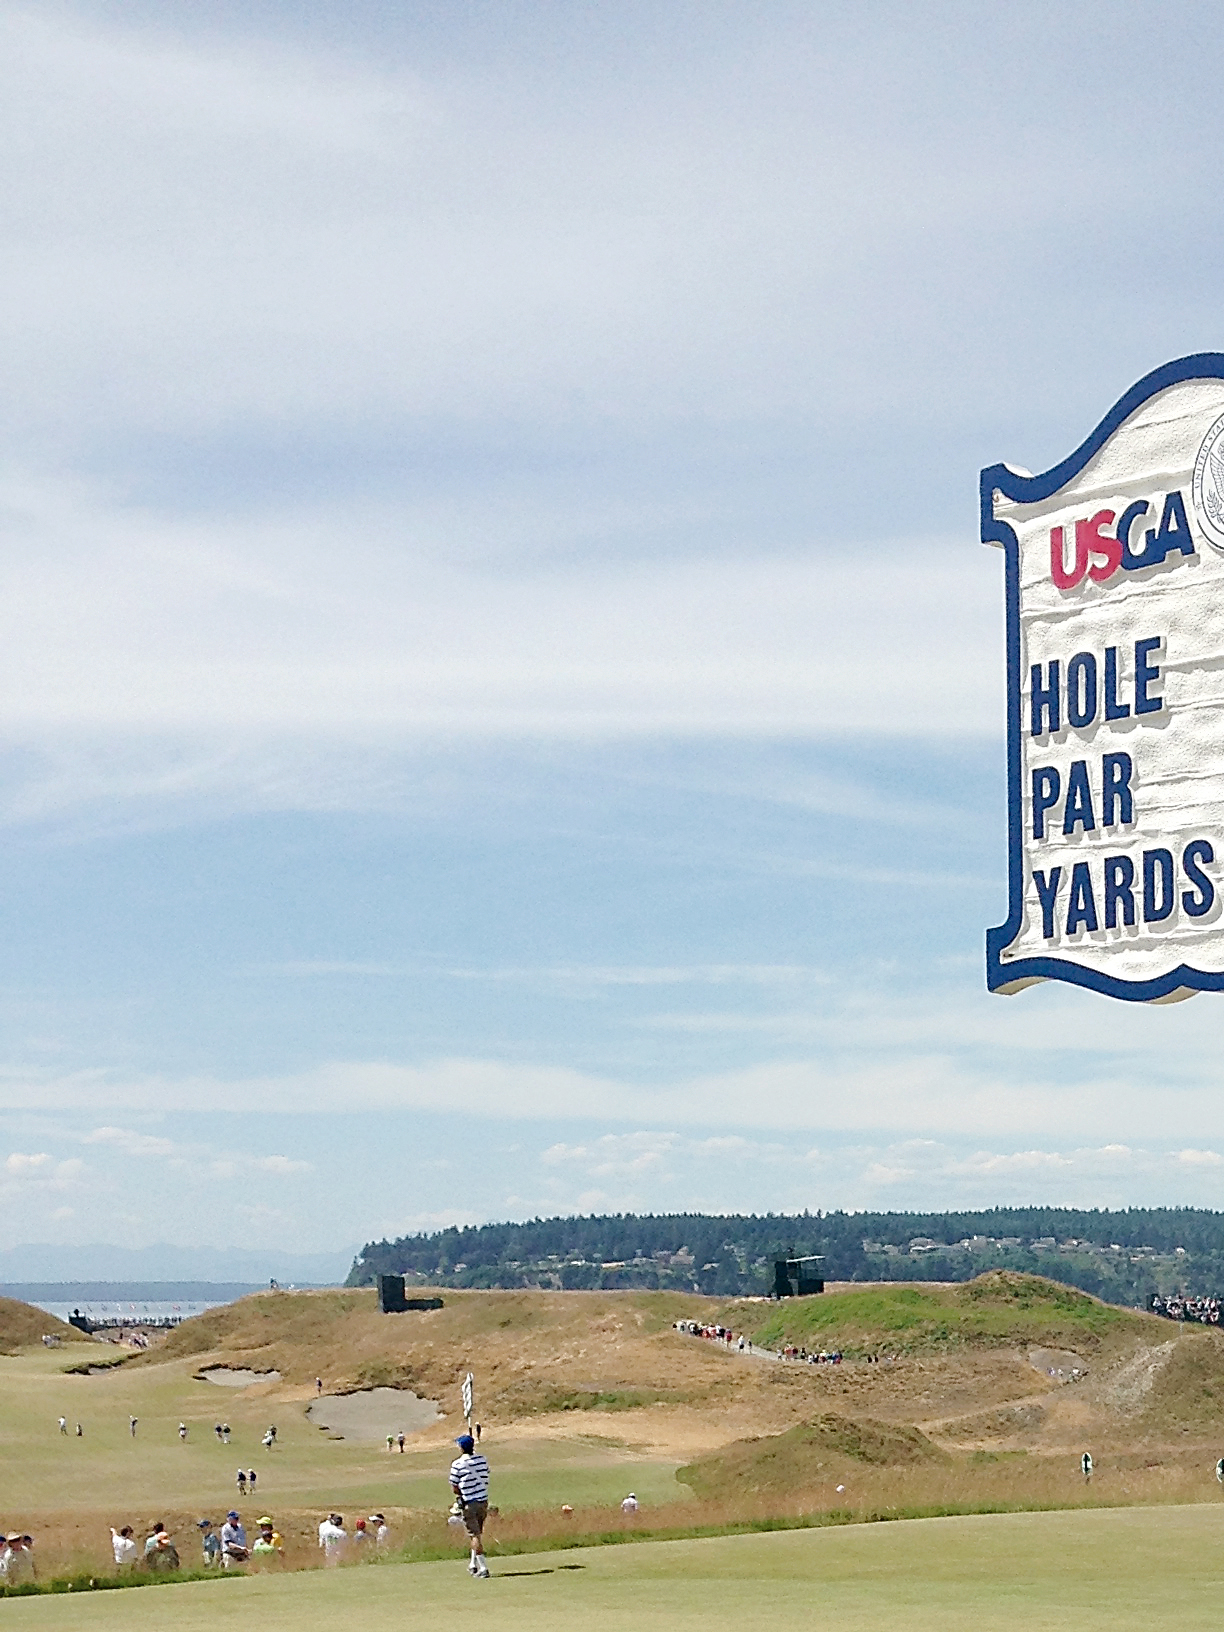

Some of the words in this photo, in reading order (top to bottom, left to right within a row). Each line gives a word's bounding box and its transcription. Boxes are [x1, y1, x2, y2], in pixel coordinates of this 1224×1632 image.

[1195, 445, 1209, 489] UNITED
[1050, 490, 1196, 590] USGA
[1032, 638, 1162, 736] HOLE
[1033, 753, 1132, 837] PAR
[1033, 841, 1214, 936] YARDS
